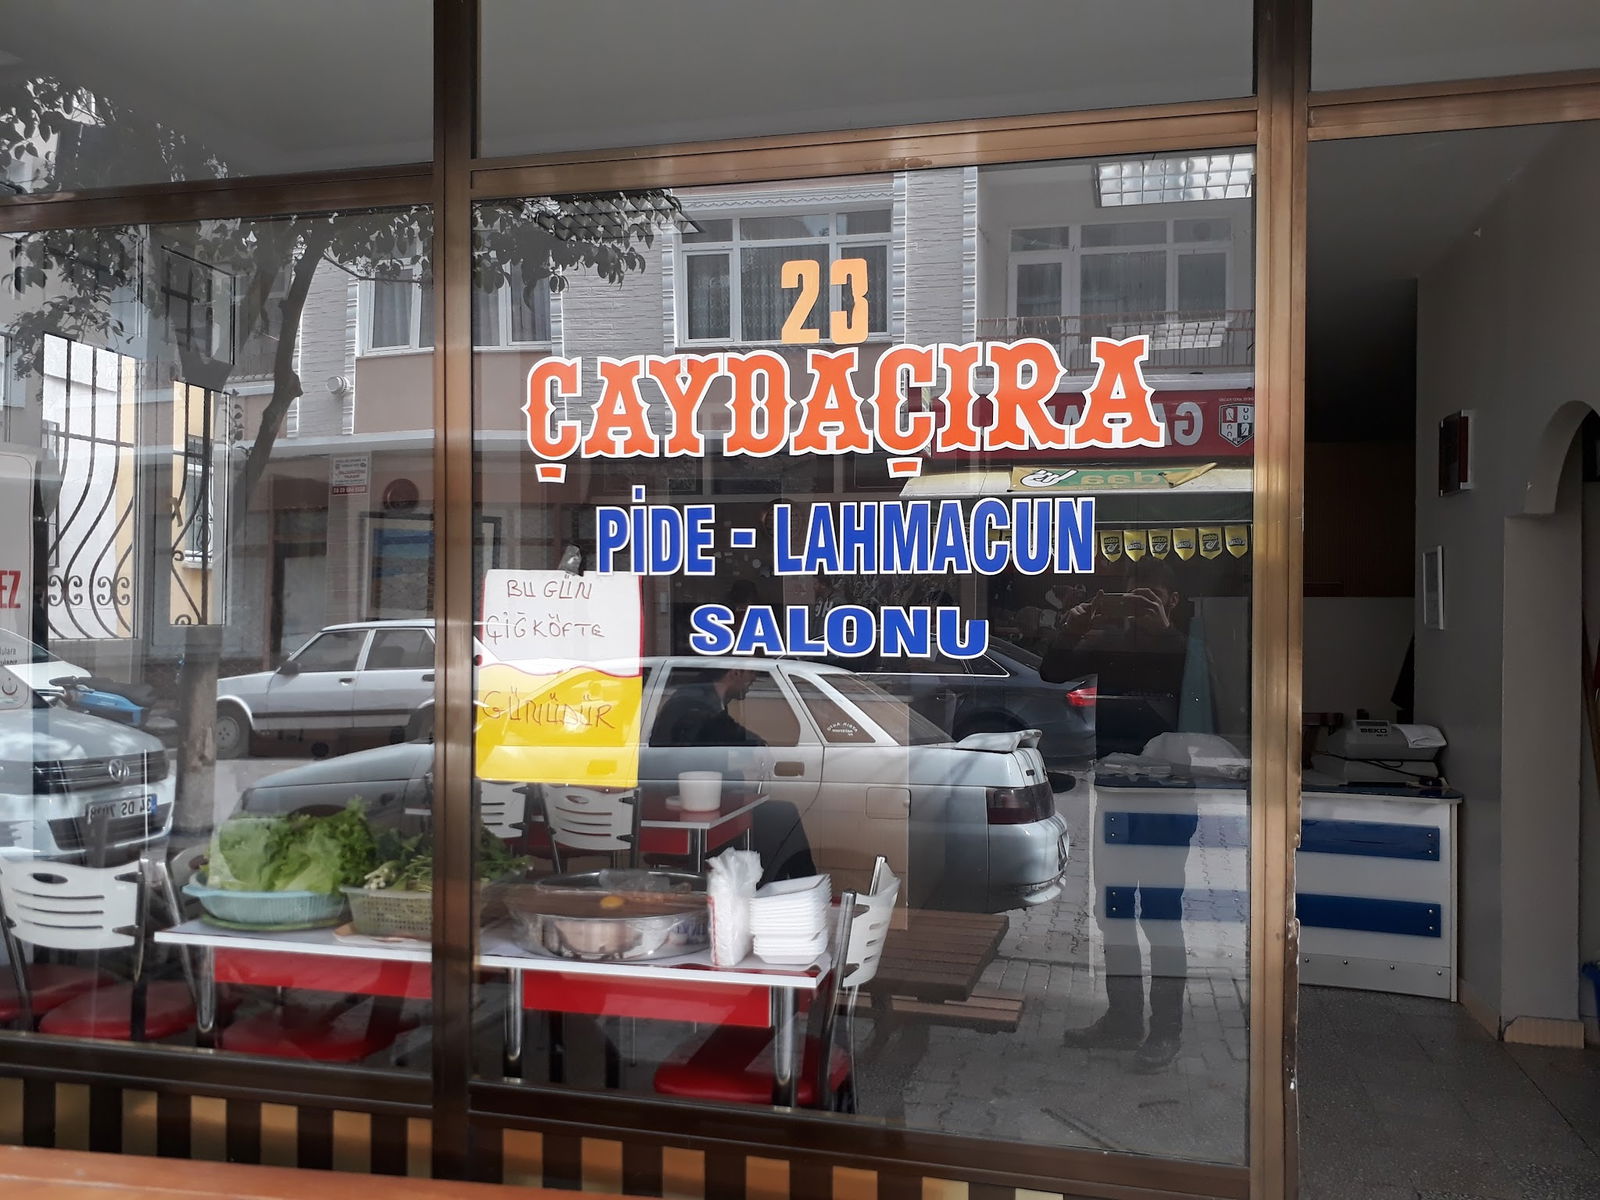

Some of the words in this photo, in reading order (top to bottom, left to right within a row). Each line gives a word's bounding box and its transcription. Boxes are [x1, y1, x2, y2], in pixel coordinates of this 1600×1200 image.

[780, 258, 870, 344] 23
[521, 334, 1165, 483] ÇAYDAÇIRA
[596, 485, 714, 576] PİDE
[773, 497, 1096, 576] LAHMACUN
[507, 579, 537, 598] BU
[543, 574, 593, 600] GÜN
[689, 603, 990, 659] SALONU
